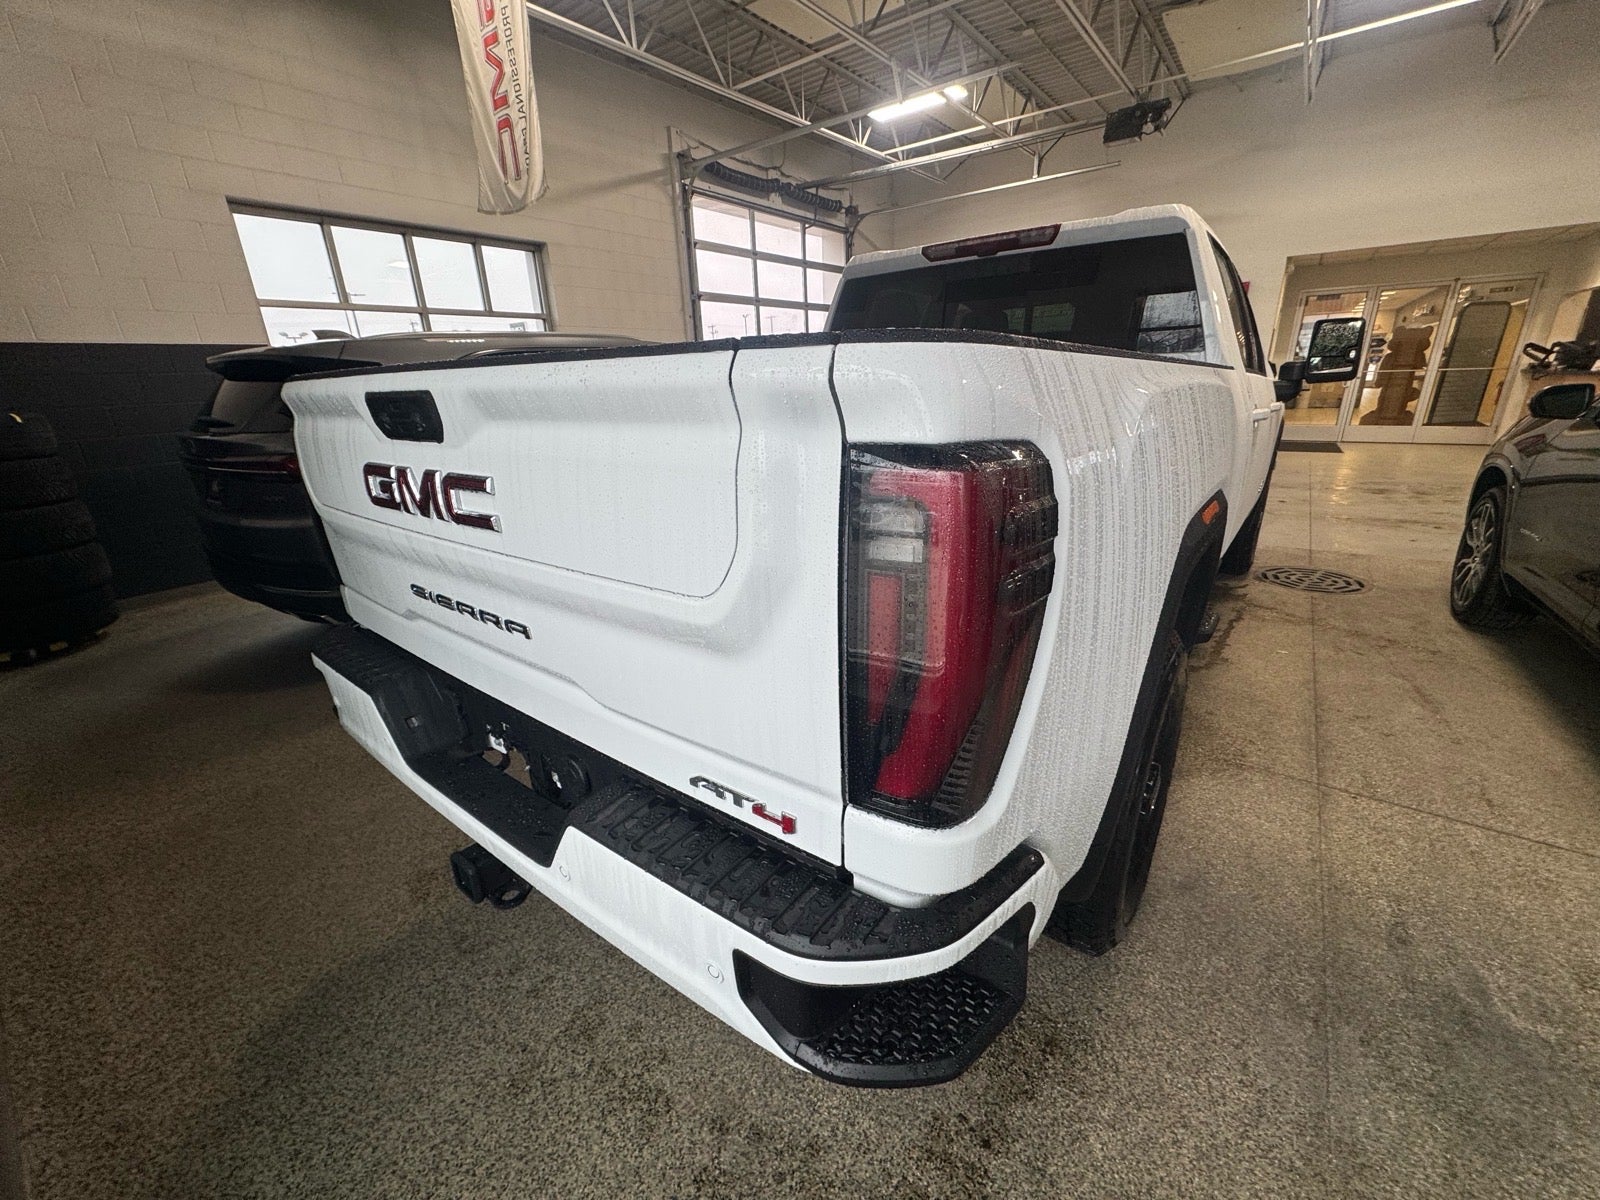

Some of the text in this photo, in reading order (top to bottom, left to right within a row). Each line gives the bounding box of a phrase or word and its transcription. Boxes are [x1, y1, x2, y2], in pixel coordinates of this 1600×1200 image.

[363, 462, 502, 533] GMC
[410, 583, 532, 640] SIERRA
[689, 775, 797, 835] AT4
